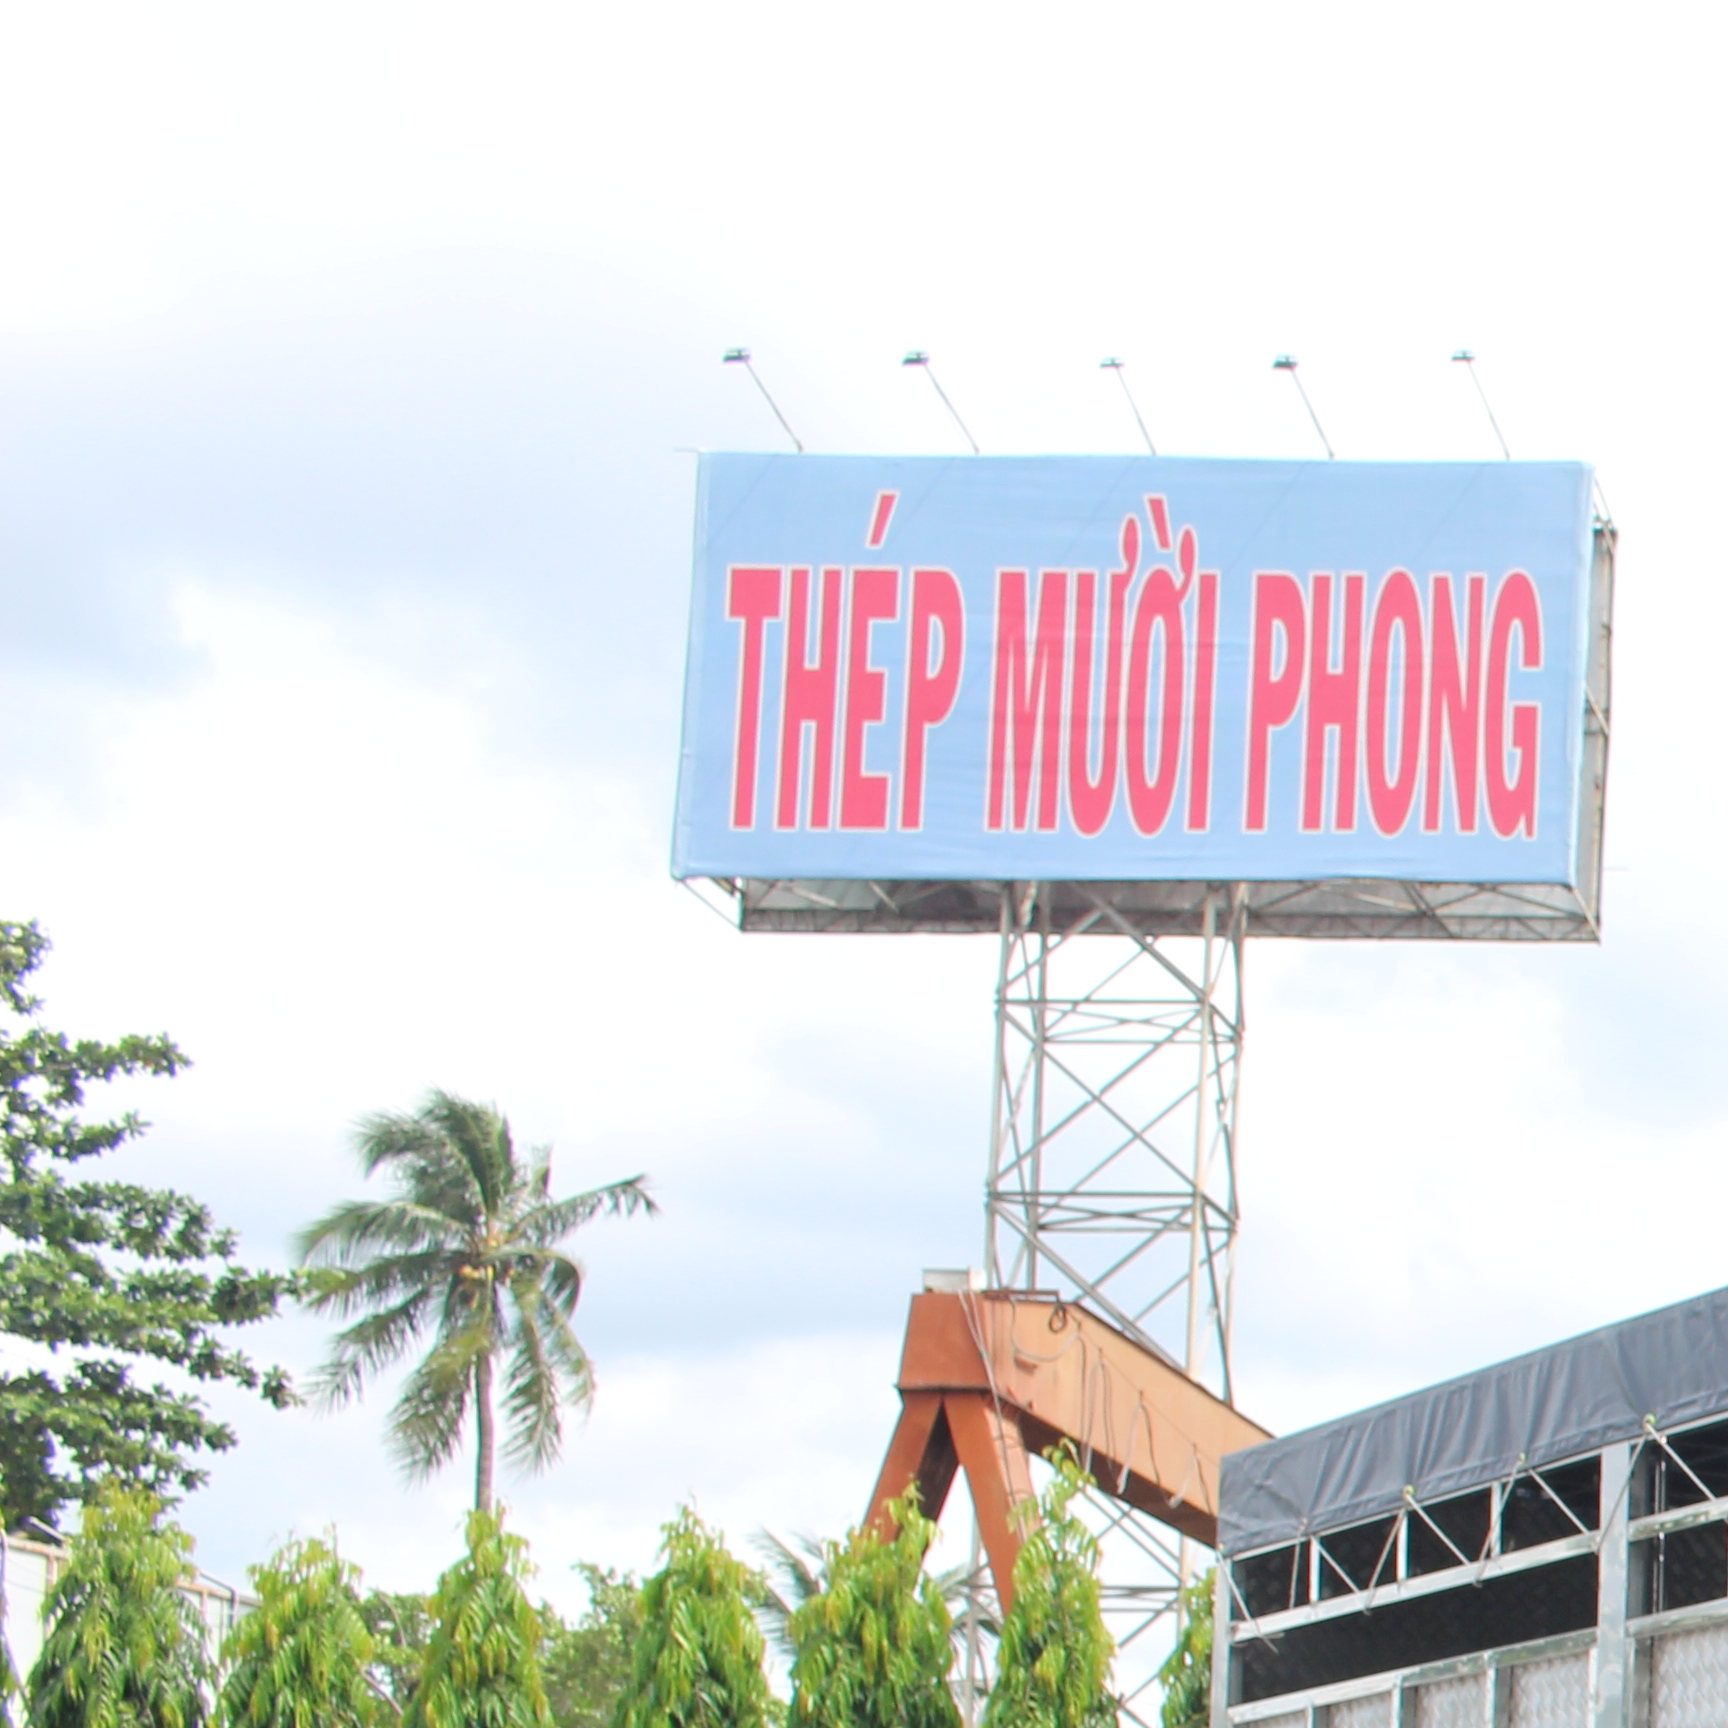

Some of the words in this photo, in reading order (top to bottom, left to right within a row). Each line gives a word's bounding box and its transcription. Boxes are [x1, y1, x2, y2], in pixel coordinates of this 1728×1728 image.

[724, 491, 966, 831] THÉP
[984, 494, 1220, 836] MƯỜI
[1243, 568, 1543, 840] PHONG
